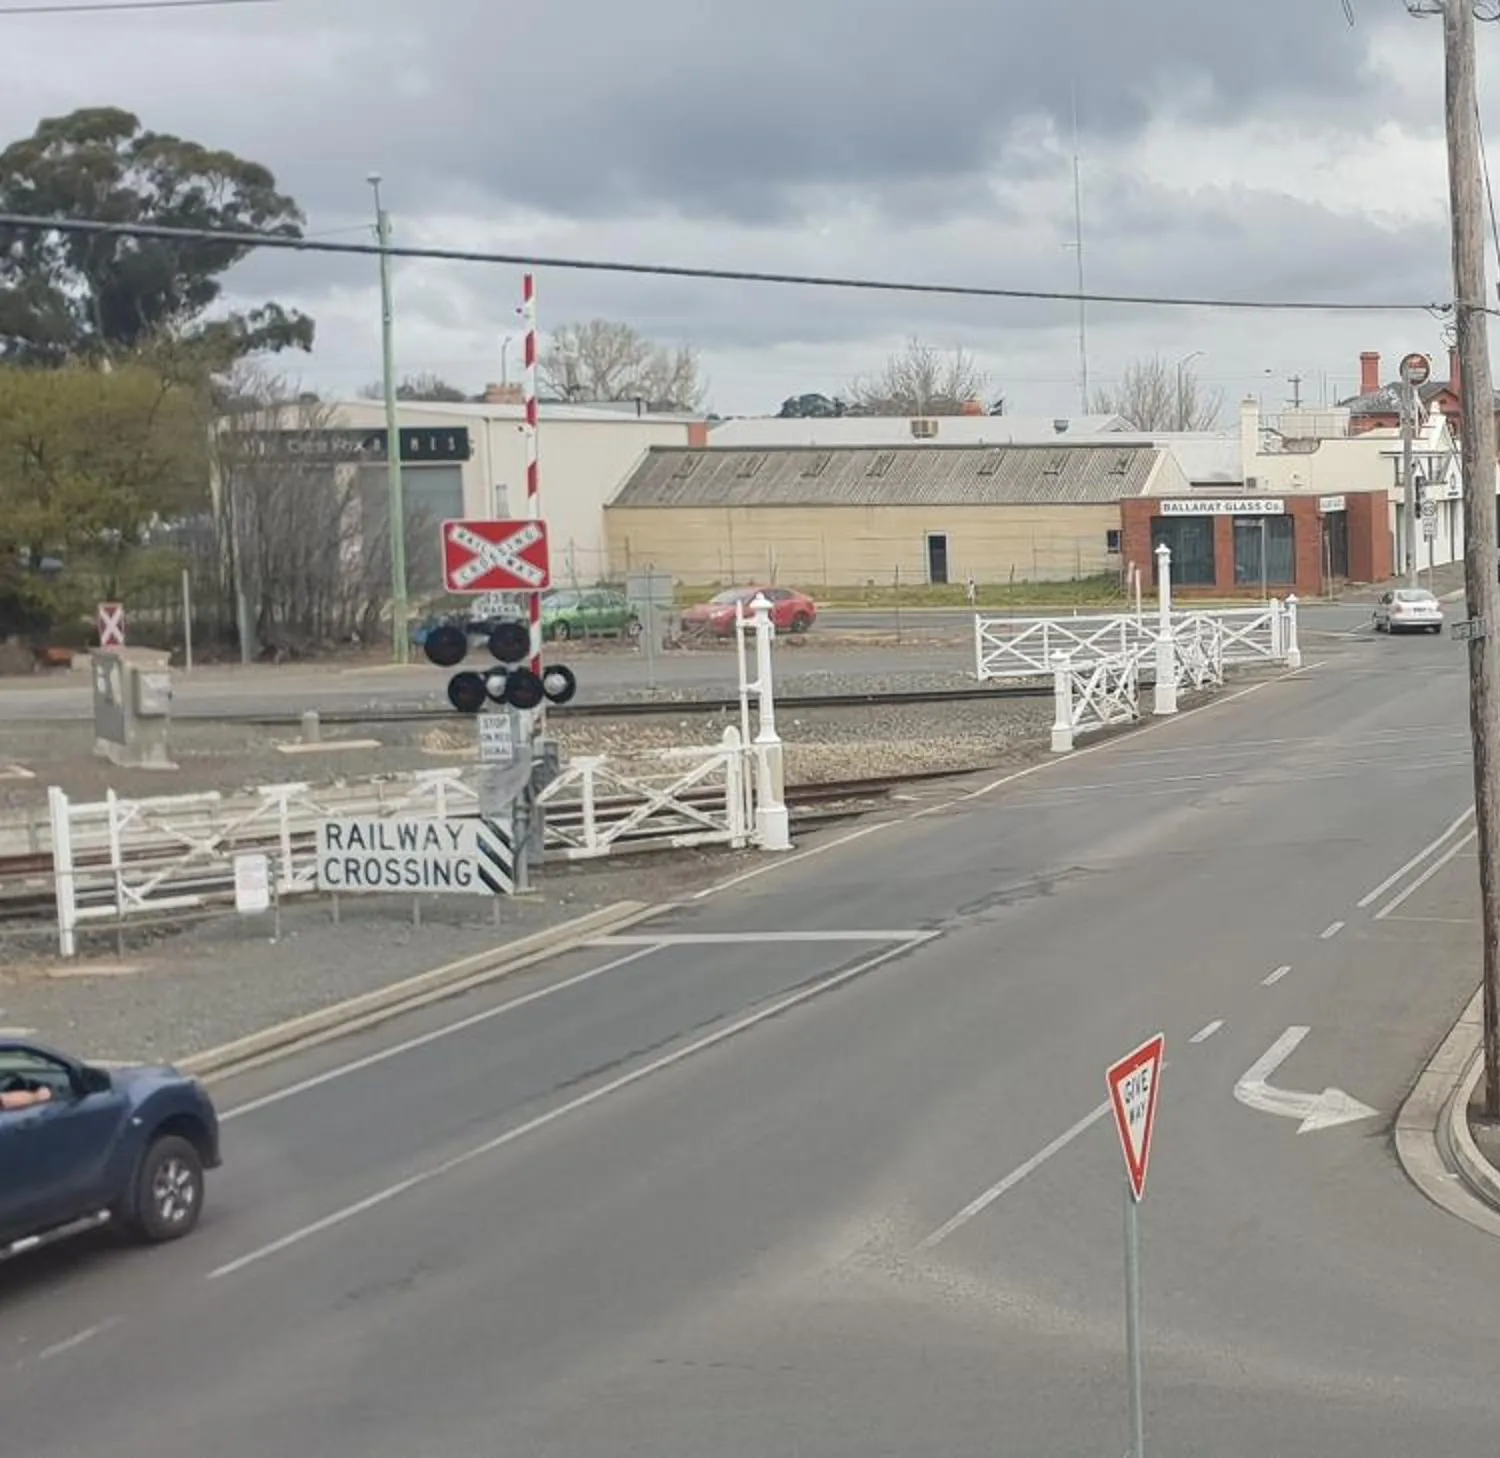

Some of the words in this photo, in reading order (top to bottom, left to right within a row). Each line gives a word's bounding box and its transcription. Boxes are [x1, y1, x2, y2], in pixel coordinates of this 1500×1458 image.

[1163, 502, 1221, 513] BALLARAT
[1225, 502, 1263, 512] GLASS
[325, 823, 465, 851] RAILWAY
[324, 858, 472, 887] CROSSING
[1125, 1068, 1148, 1105] GIVE
[1129, 1101, 1146, 1126] WAY
